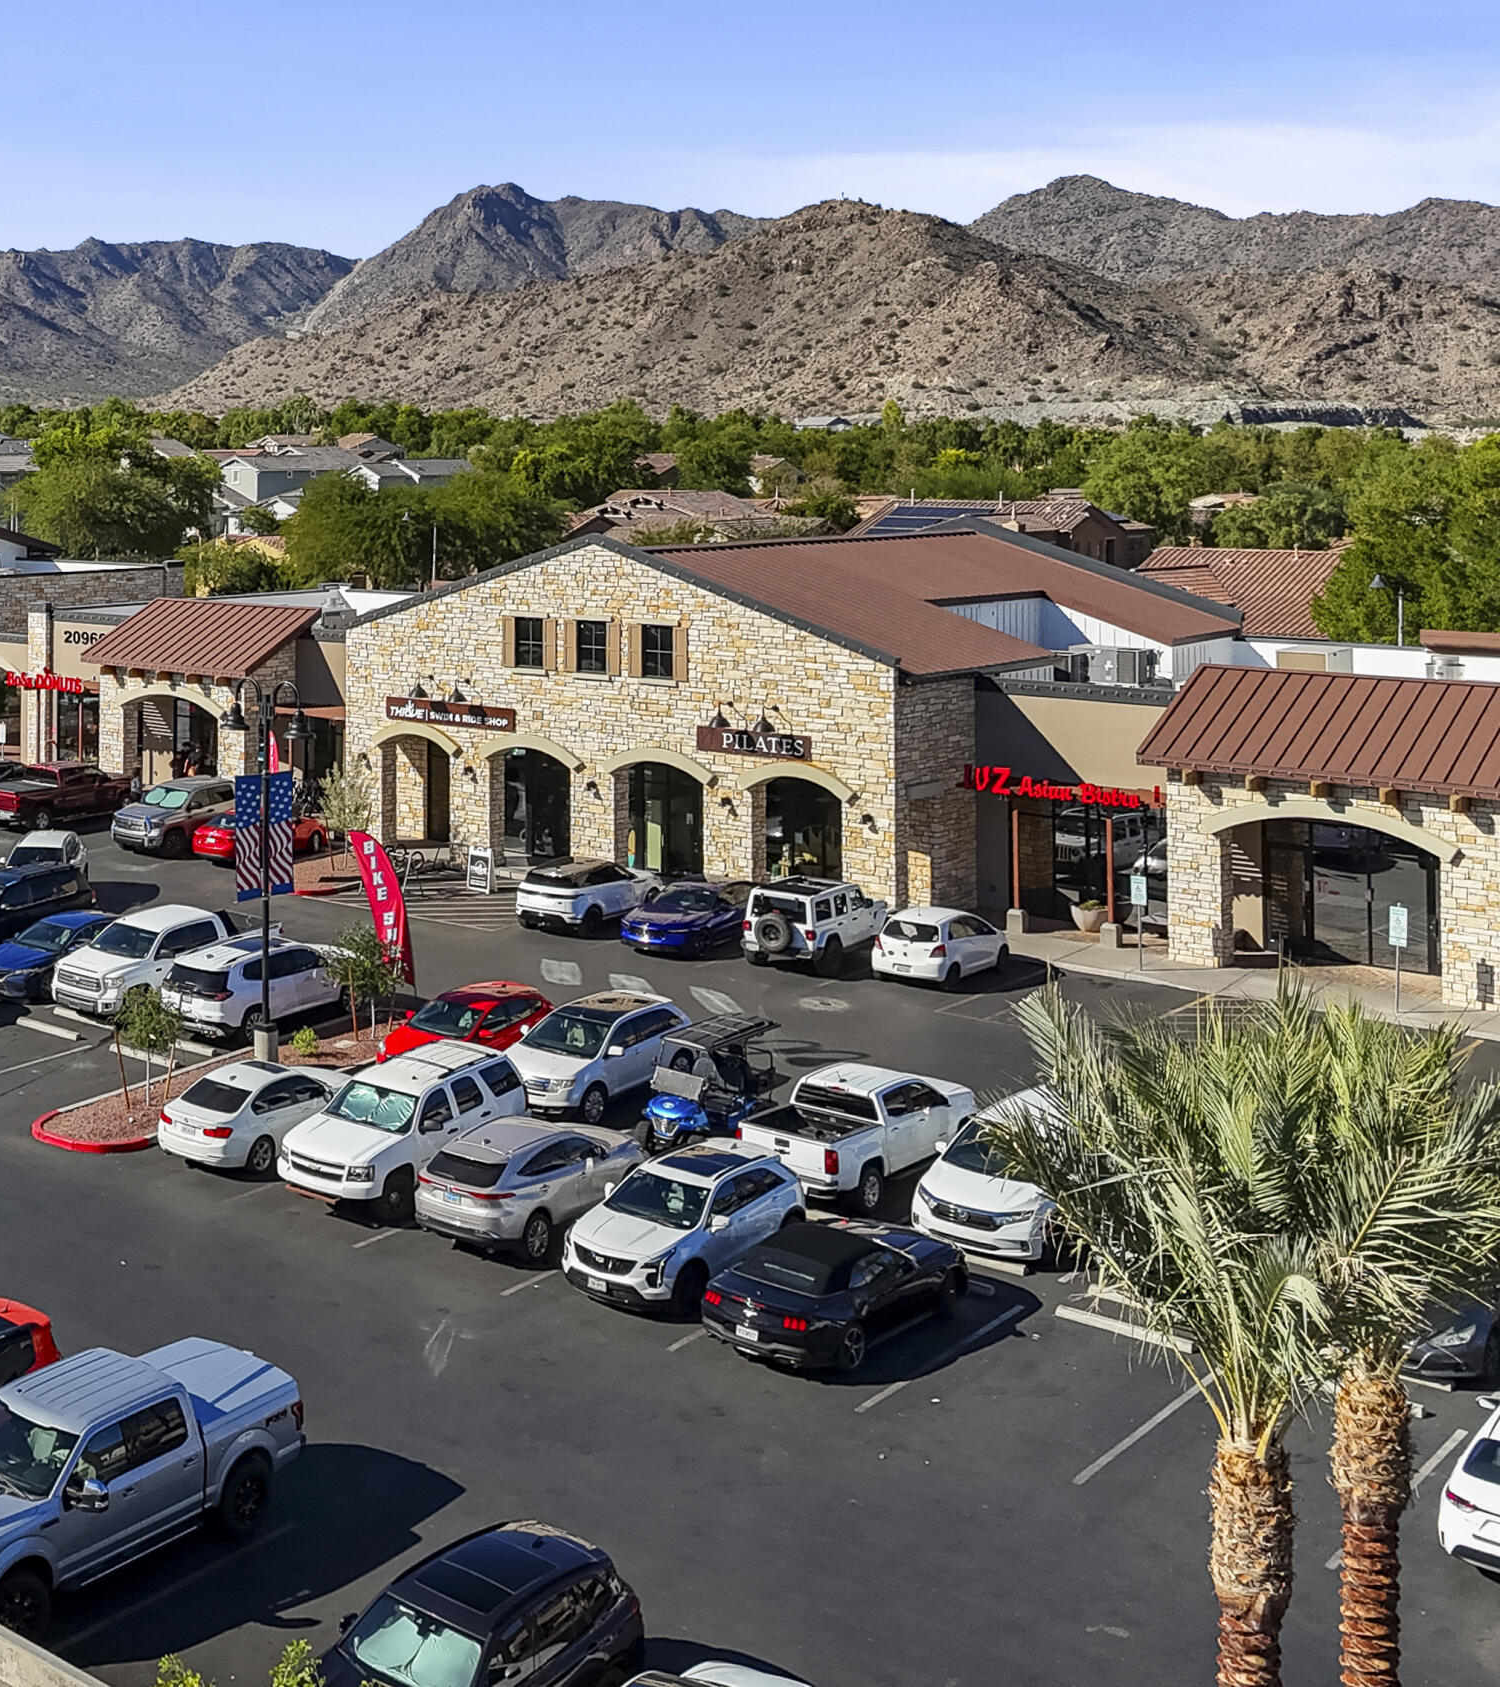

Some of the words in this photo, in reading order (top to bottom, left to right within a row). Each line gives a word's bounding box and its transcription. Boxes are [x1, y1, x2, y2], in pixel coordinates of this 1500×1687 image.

[35, 673, 83, 694] DONUTS
[454, 713, 461, 722] &
[484, 717, 509, 728] SHOP
[721, 732, 804, 756] PILATES
[1017, 776, 1073, 801] Asian
[1077, 783, 1140, 808] Bistro
[363, 839, 389, 901] BIKE
